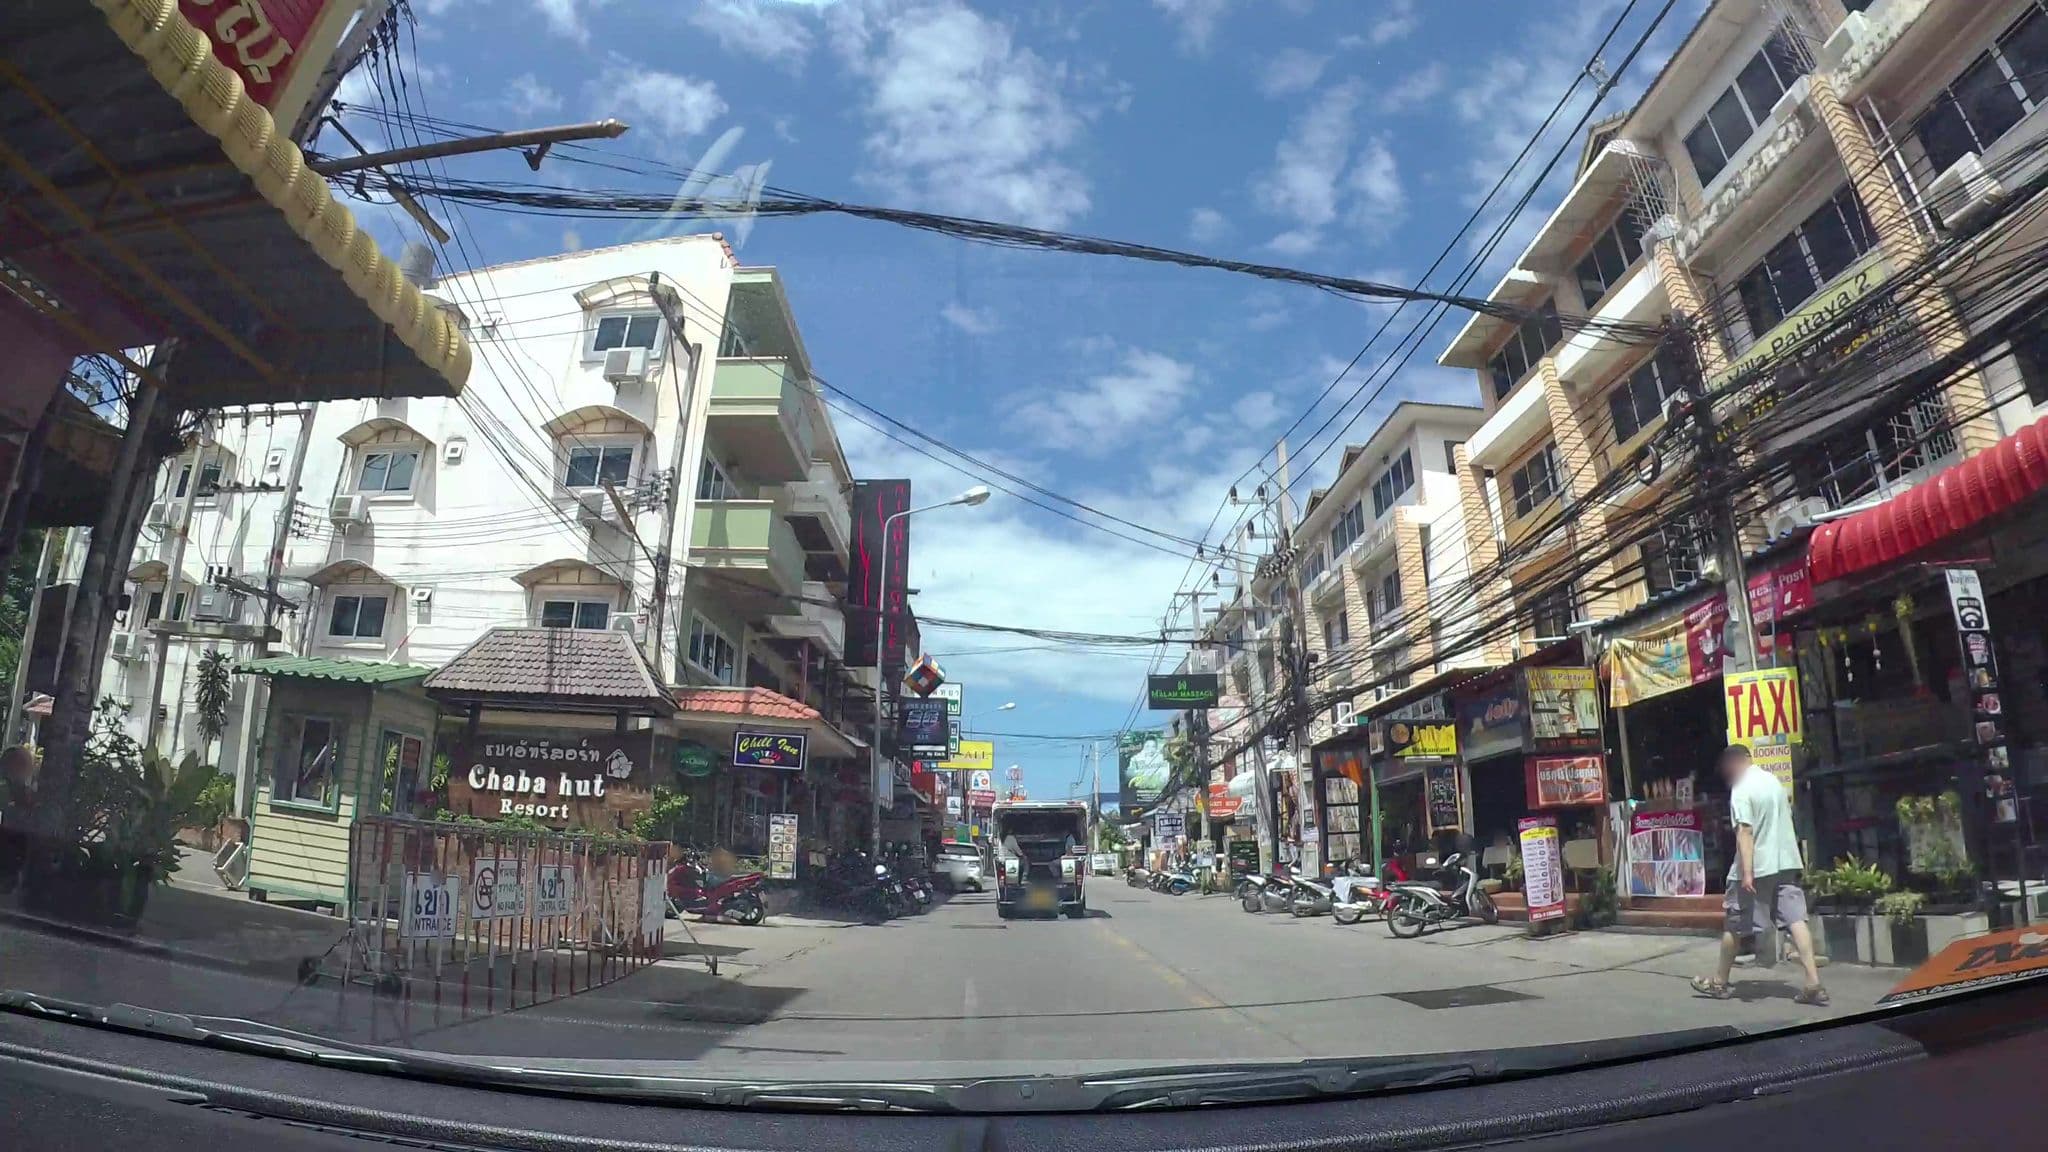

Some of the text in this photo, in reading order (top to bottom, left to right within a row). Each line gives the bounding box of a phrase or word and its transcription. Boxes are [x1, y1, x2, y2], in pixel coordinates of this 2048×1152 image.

[1771, 290, 1852, 355] Pattaya
[1855, 272, 1871, 293] 2
[1728, 679, 1798, 738] TAXI
[739, 736, 799, 755] Chill Inn
[468, 763, 605, 797] Chaba hut
[500, 798, 569, 819] Resort
